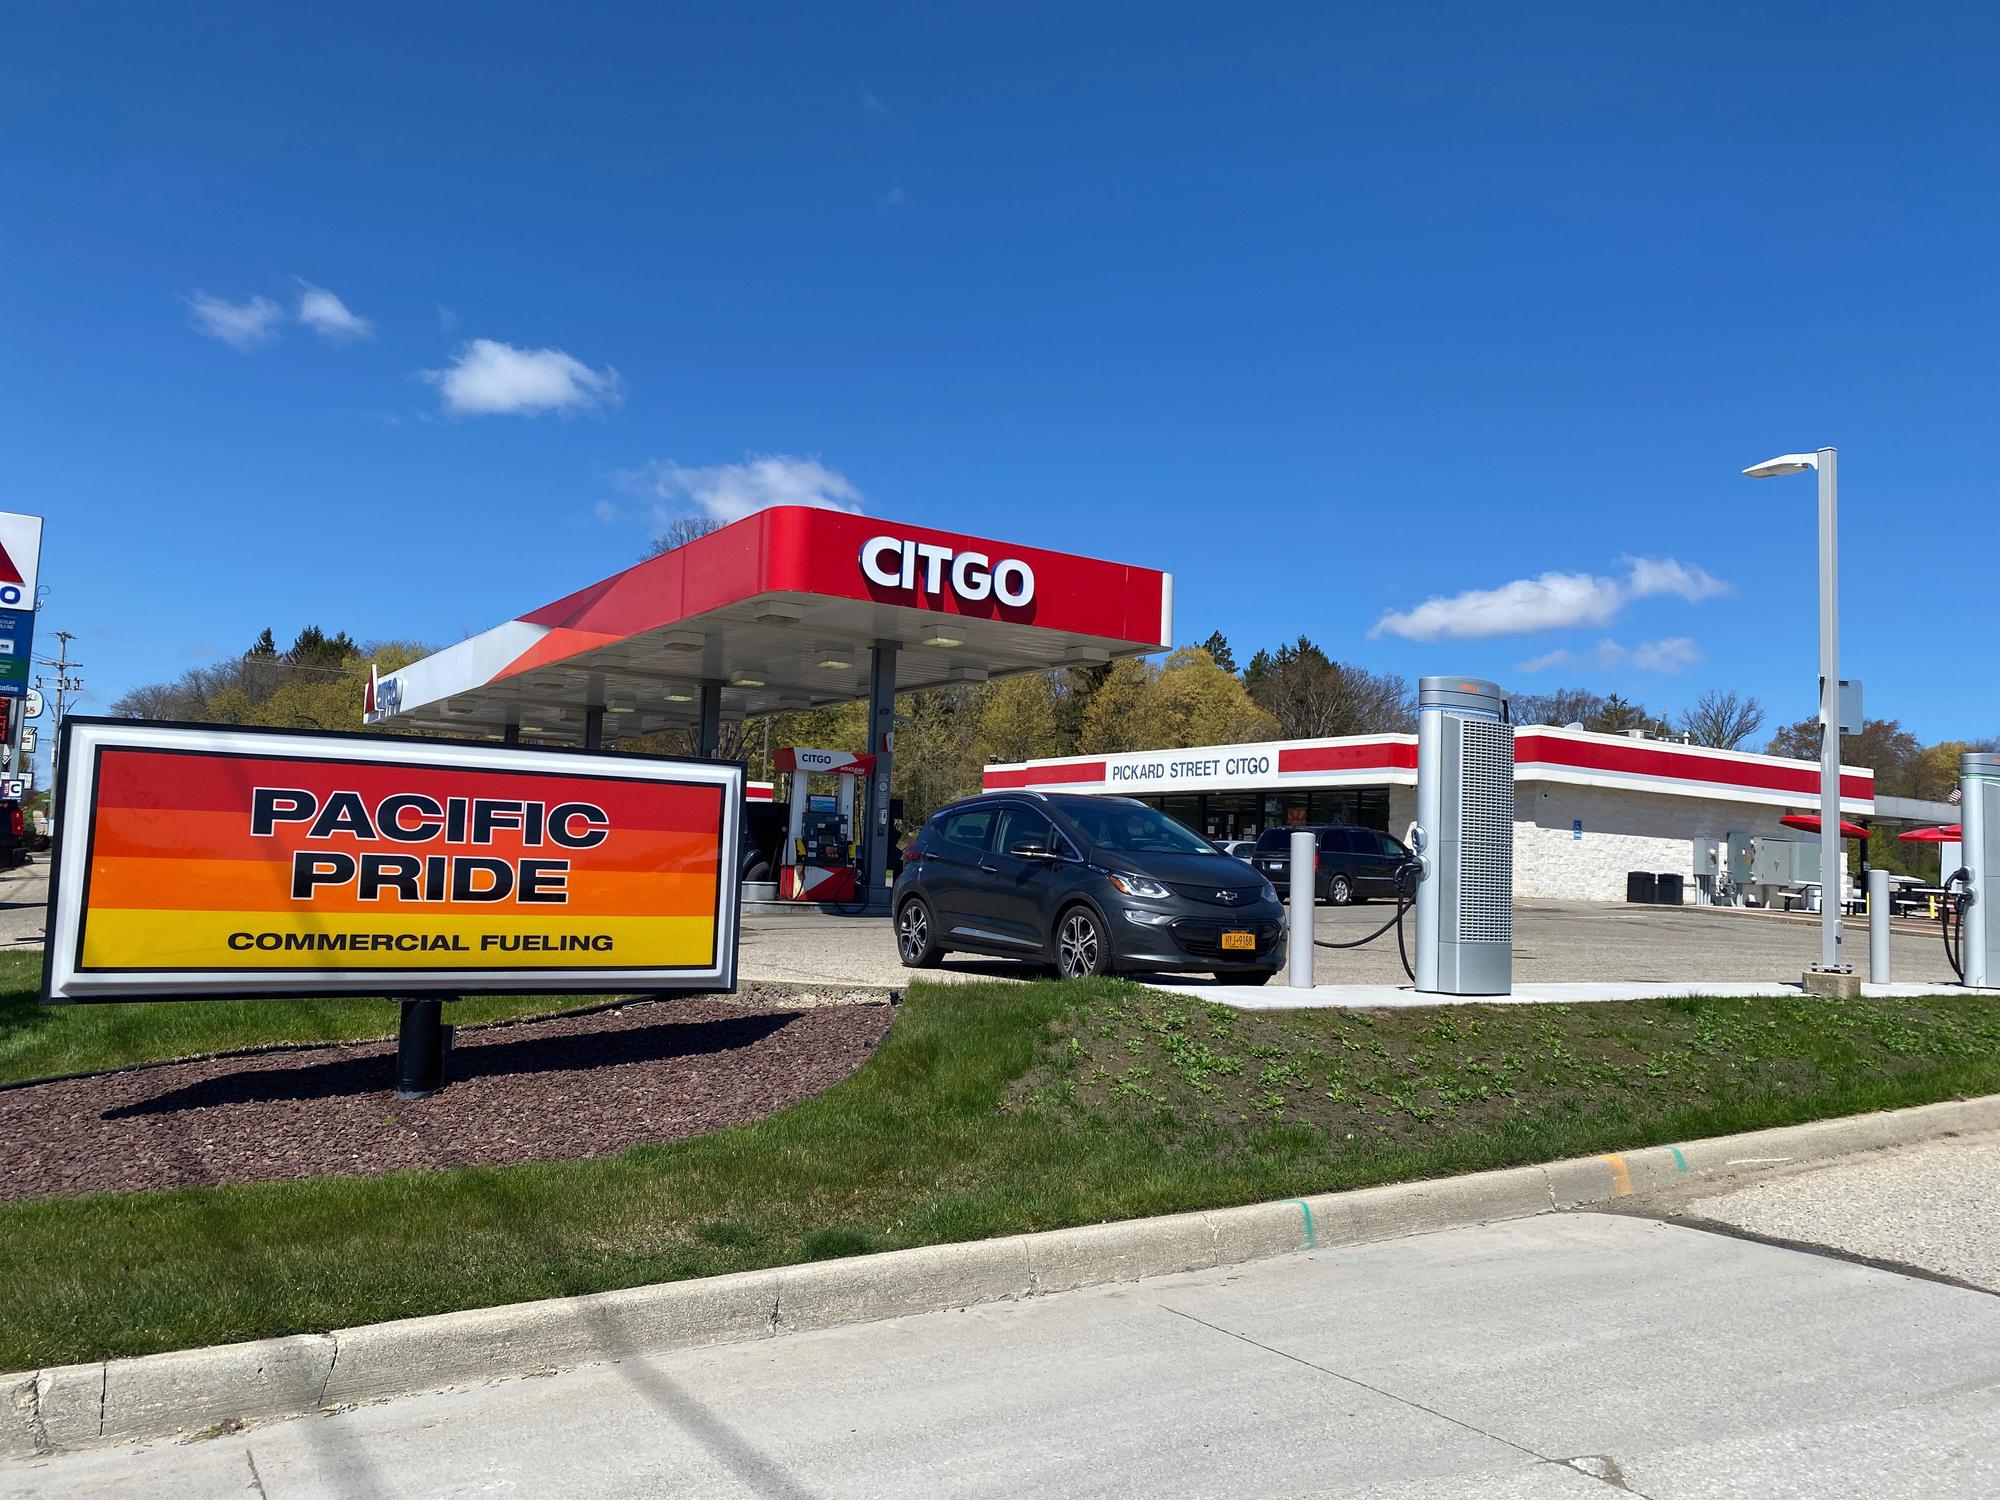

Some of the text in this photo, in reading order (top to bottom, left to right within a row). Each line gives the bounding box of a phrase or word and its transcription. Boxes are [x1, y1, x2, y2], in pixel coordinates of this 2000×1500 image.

[861, 536, 1035, 607] CITGO
[802, 753, 832, 765] CITGO
[1113, 756, 1269, 781] PICKARD STREET CITGO
[249, 786, 610, 849] PACIFIC
[290, 851, 571, 905] PRIDE
[227, 932, 614, 953] COMMERCIAL FUELING
